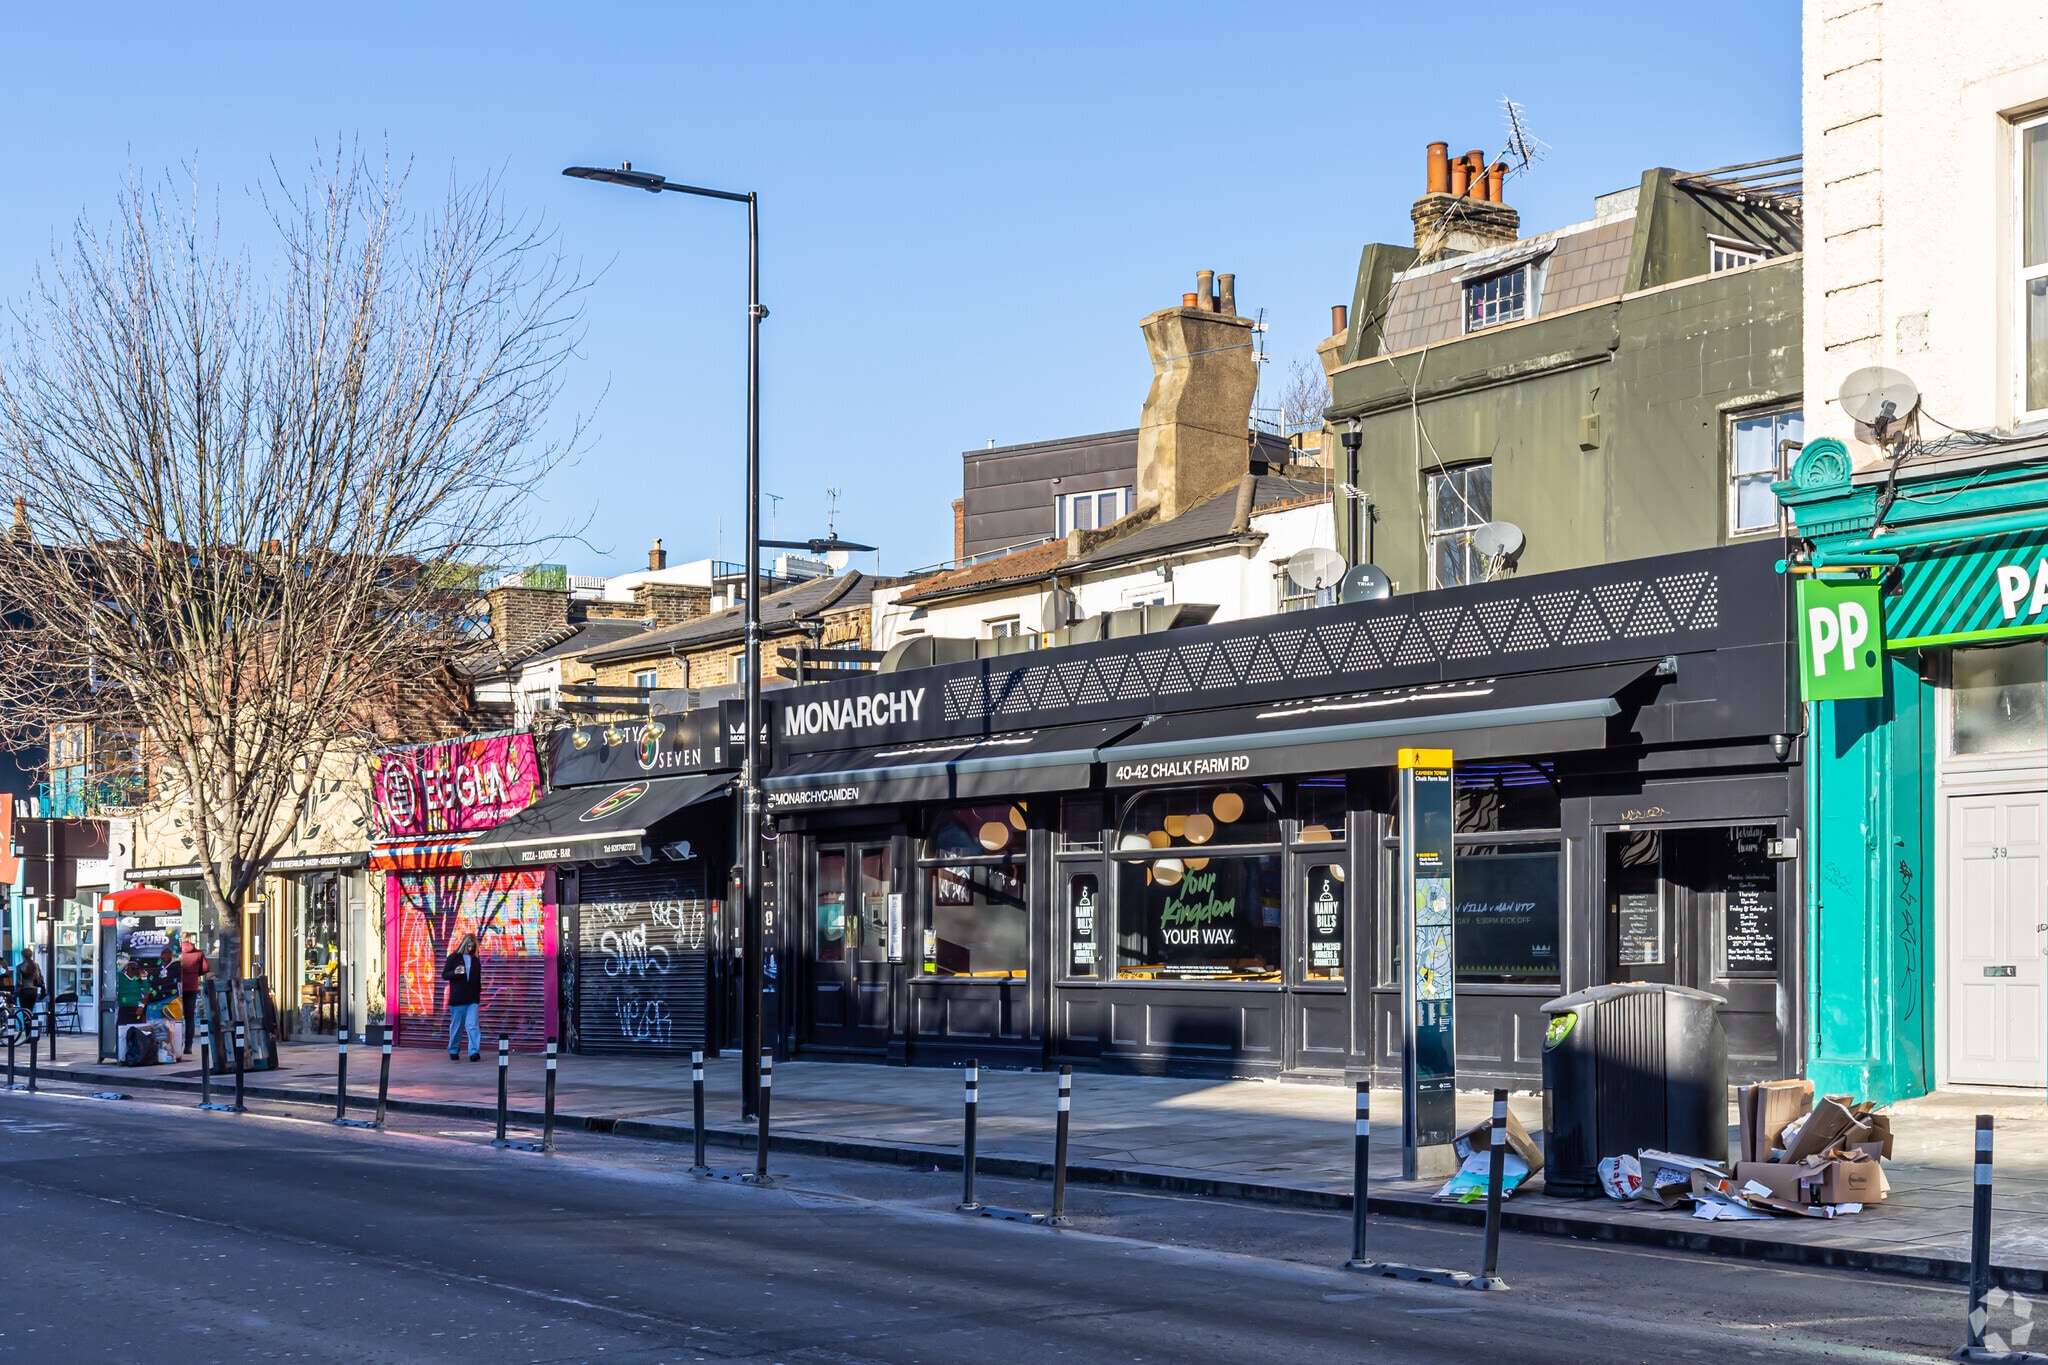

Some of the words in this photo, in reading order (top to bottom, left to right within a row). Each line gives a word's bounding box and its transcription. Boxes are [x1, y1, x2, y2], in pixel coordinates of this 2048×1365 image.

[785, 688, 925, 736] MONARCHY
[603, 726, 639, 746] STY
[658, 749, 701, 768] SEVEN
[1116, 764, 1149, 780] 40-42
[1151, 760, 1192, 778] CHALK
[1194, 757, 1229, 774] FARM
[1231, 755, 1250, 771] RD
[767, 787, 859, 808] @MONARCHYCAMDEN
[1729, 826, 1762, 843] Holiday
[1738, 839, 1759, 853] hours
[1992, 847, 2008, 859] 39
[522, 851, 536, 861] PIZZA
[538, 850, 557, 859] LOUNGE
[560, 848, 571, 858] BAR
[1180, 866, 1216, 900] Your
[1075, 906, 1094, 917] NANNY
[1161, 889, 1236, 929] Kingdom
[1314, 901, 1338, 915] NANNY
[1462, 902, 1488, 912] VILLA
[1494, 901, 1514, 912] MAN
[1515, 902, 1536, 912] UTD
[1750, 905, 1768, 913] Saturday
[1500, 916, 1516, 924] KICK
[130, 935, 170, 947] SOUND
[132, 930, 166, 938] CHAMPION
[1162, 929, 1199, 945] YOUR
[1202, 929, 1234, 945] WAY.
